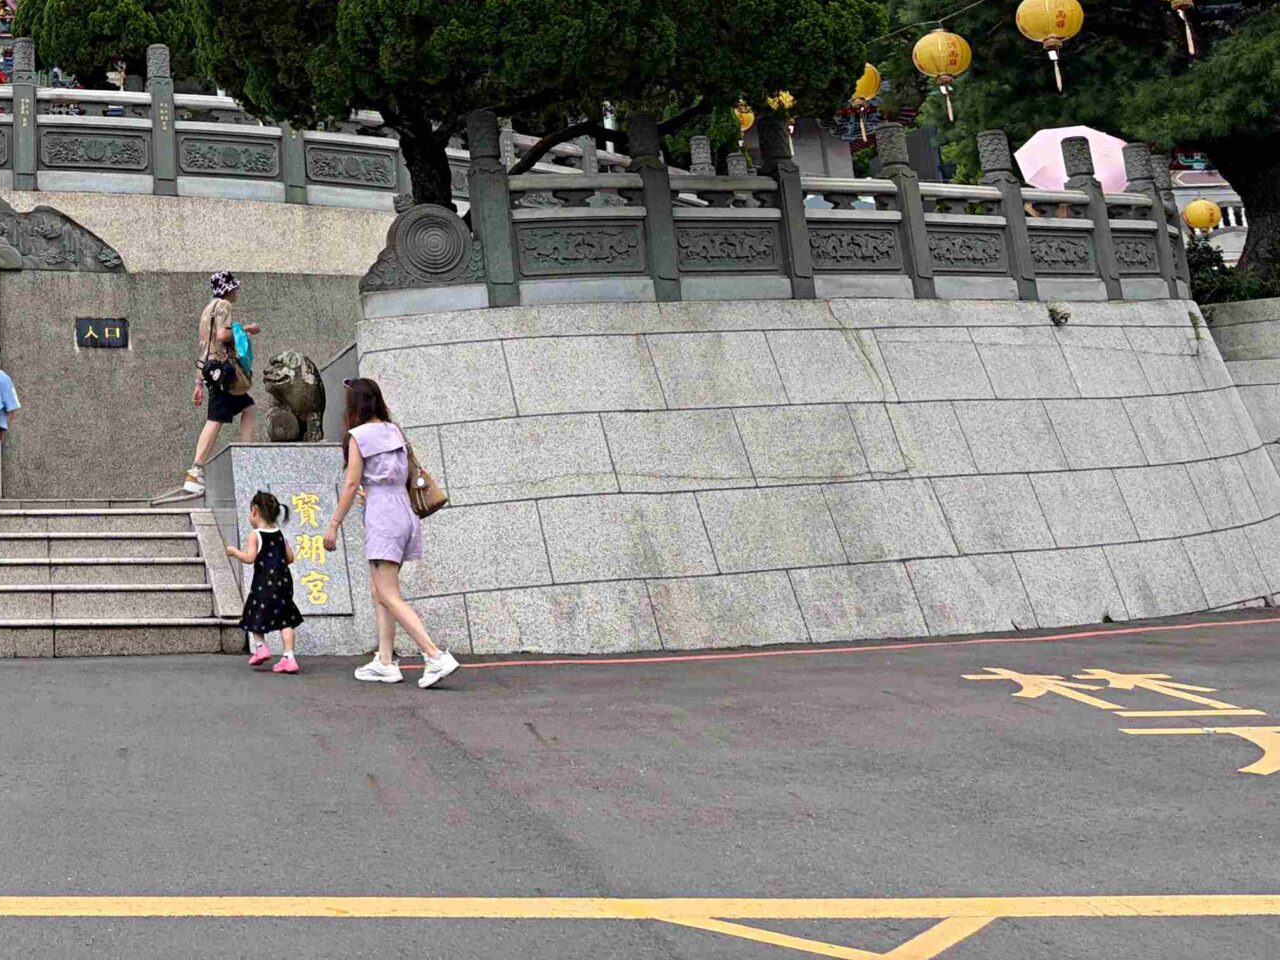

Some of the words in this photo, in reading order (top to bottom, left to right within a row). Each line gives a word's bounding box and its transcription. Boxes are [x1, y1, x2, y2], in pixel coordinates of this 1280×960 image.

[83, 326, 121, 339] 入口
[292, 492, 330, 605] 寶湖宮
